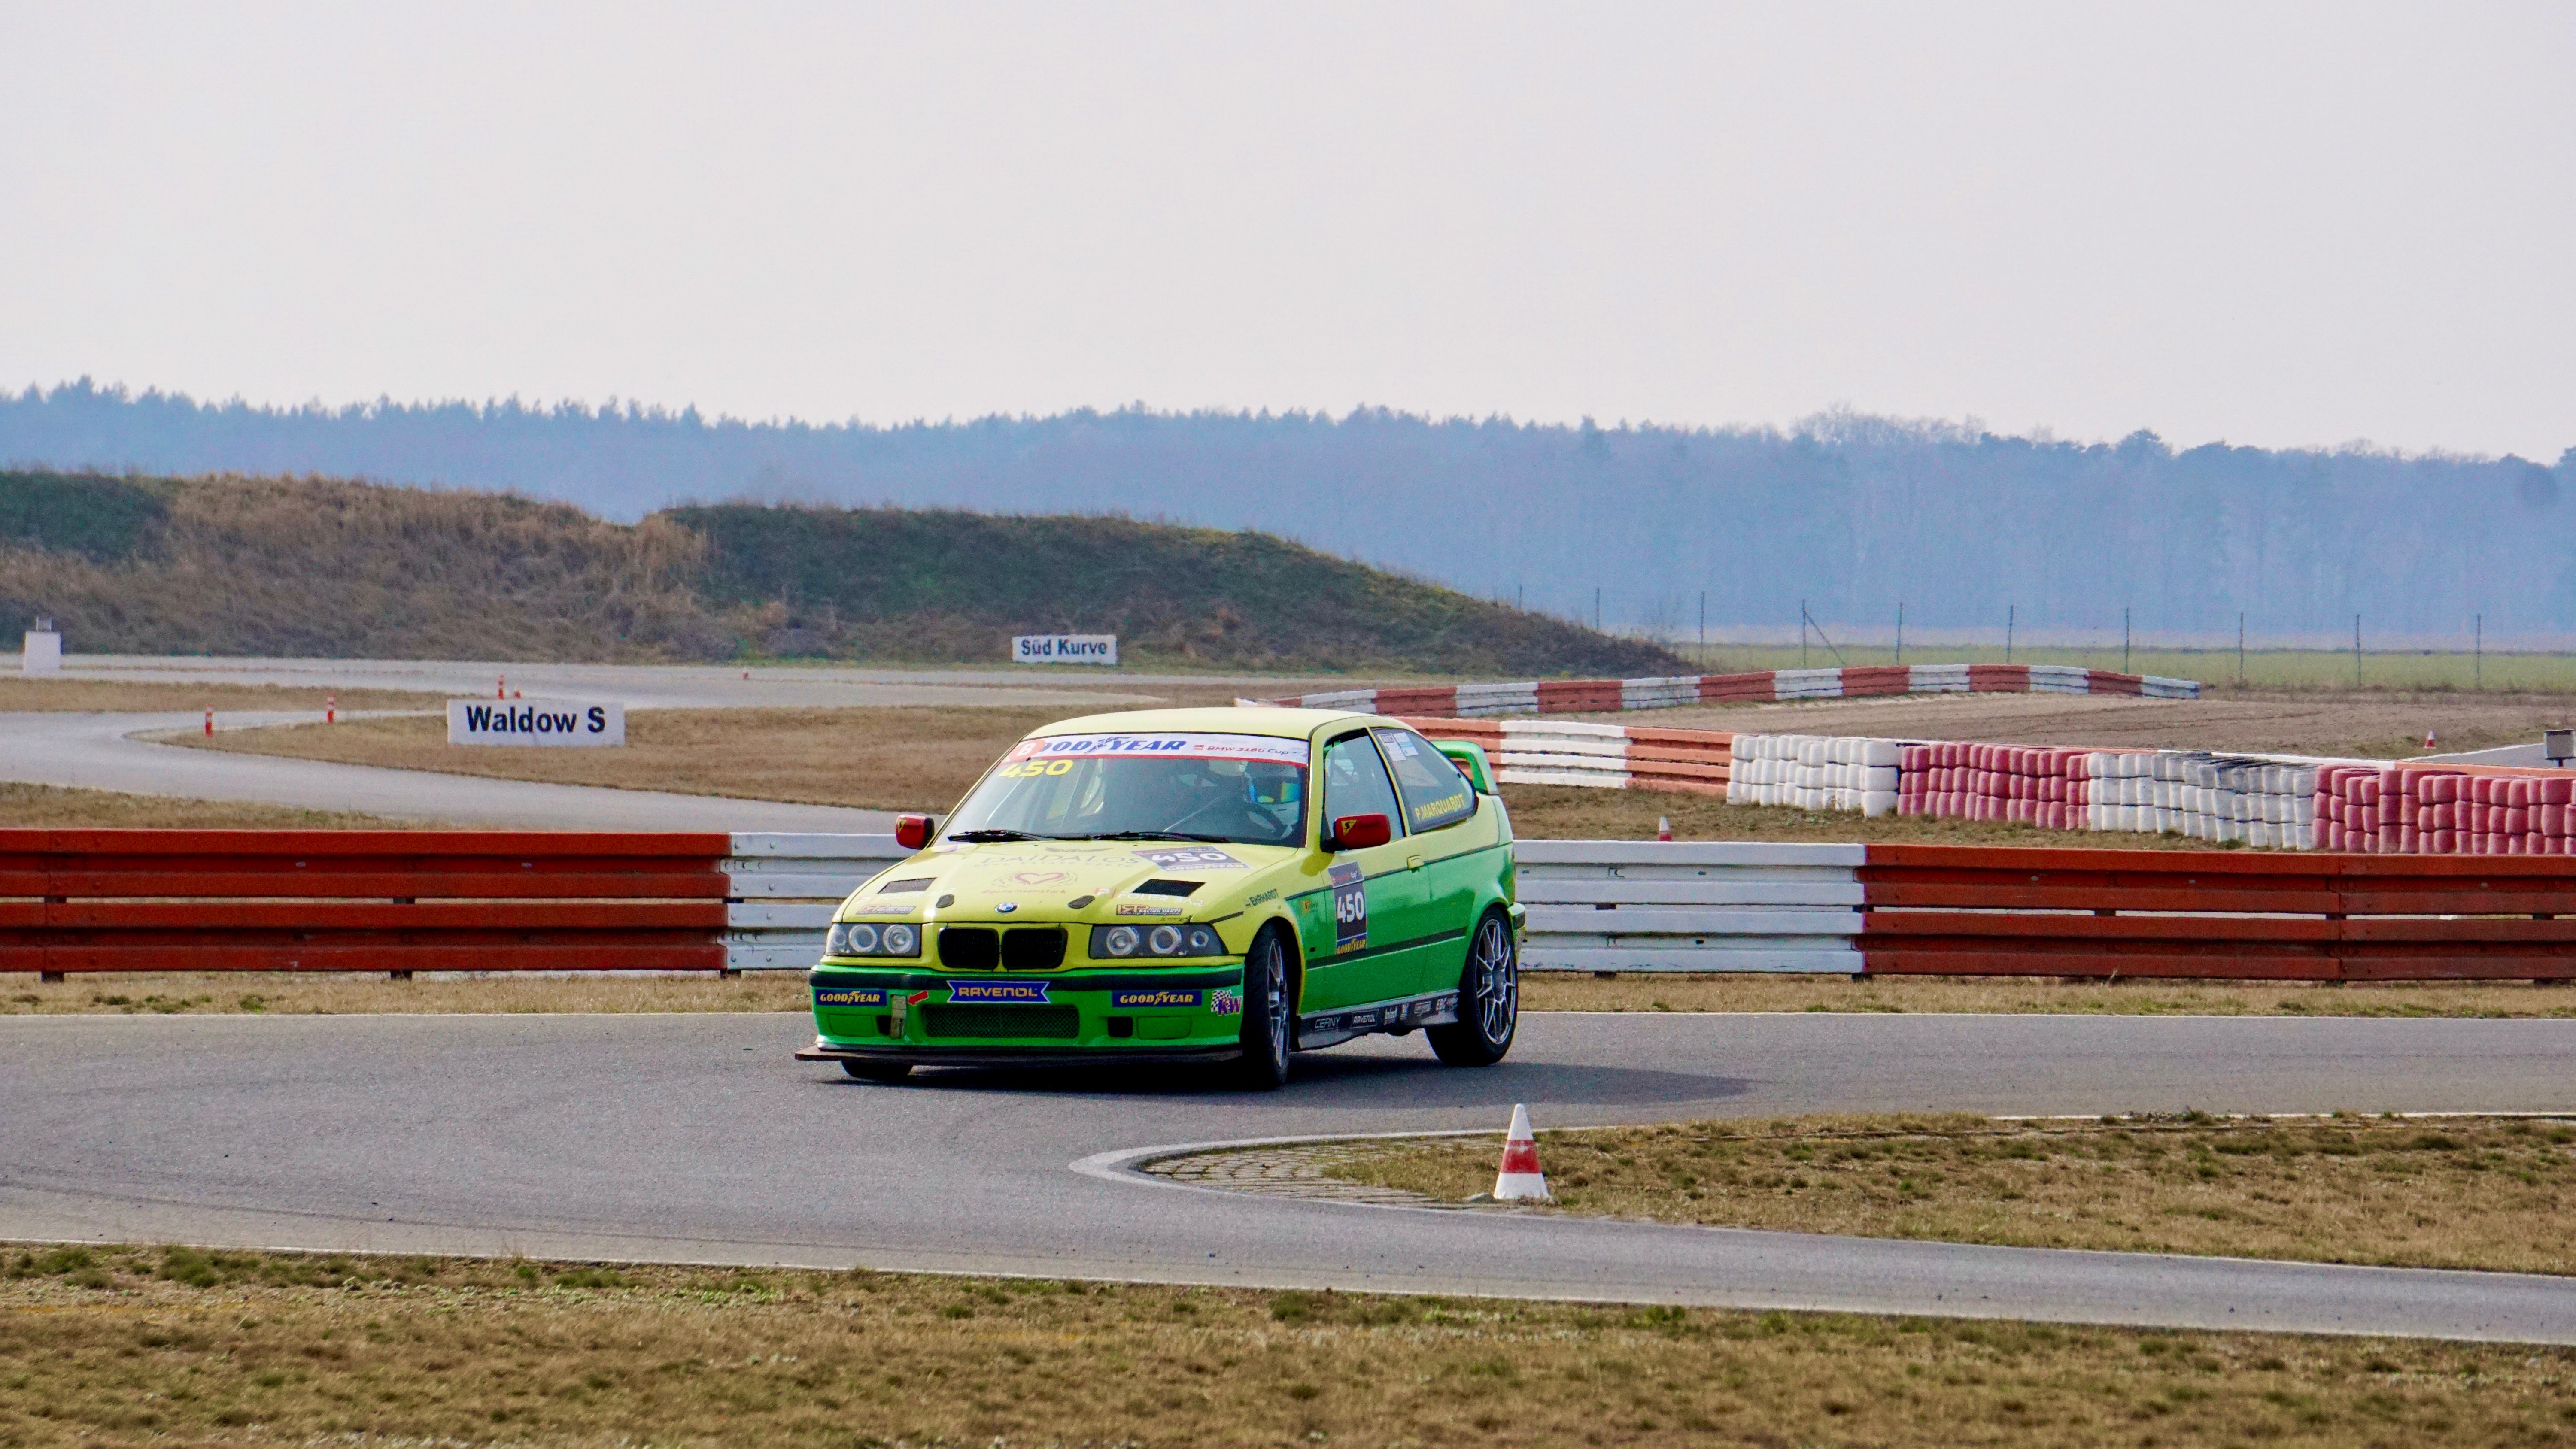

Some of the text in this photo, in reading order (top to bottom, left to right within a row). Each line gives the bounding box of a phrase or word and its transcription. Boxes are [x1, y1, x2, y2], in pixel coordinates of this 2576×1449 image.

[1021, 638, 1107, 655] Süd Kurve
[466, 706, 605, 733] Waldow S
[999, 760, 1073, 778] 450
[1152, 852, 1227, 862] 450
[1337, 891, 1364, 923] 450
[820, 992, 881, 1003] GOODYEAR
[958, 987, 1038, 997] RAVENOL
[1120, 993, 1194, 1004] GOODYEAR
